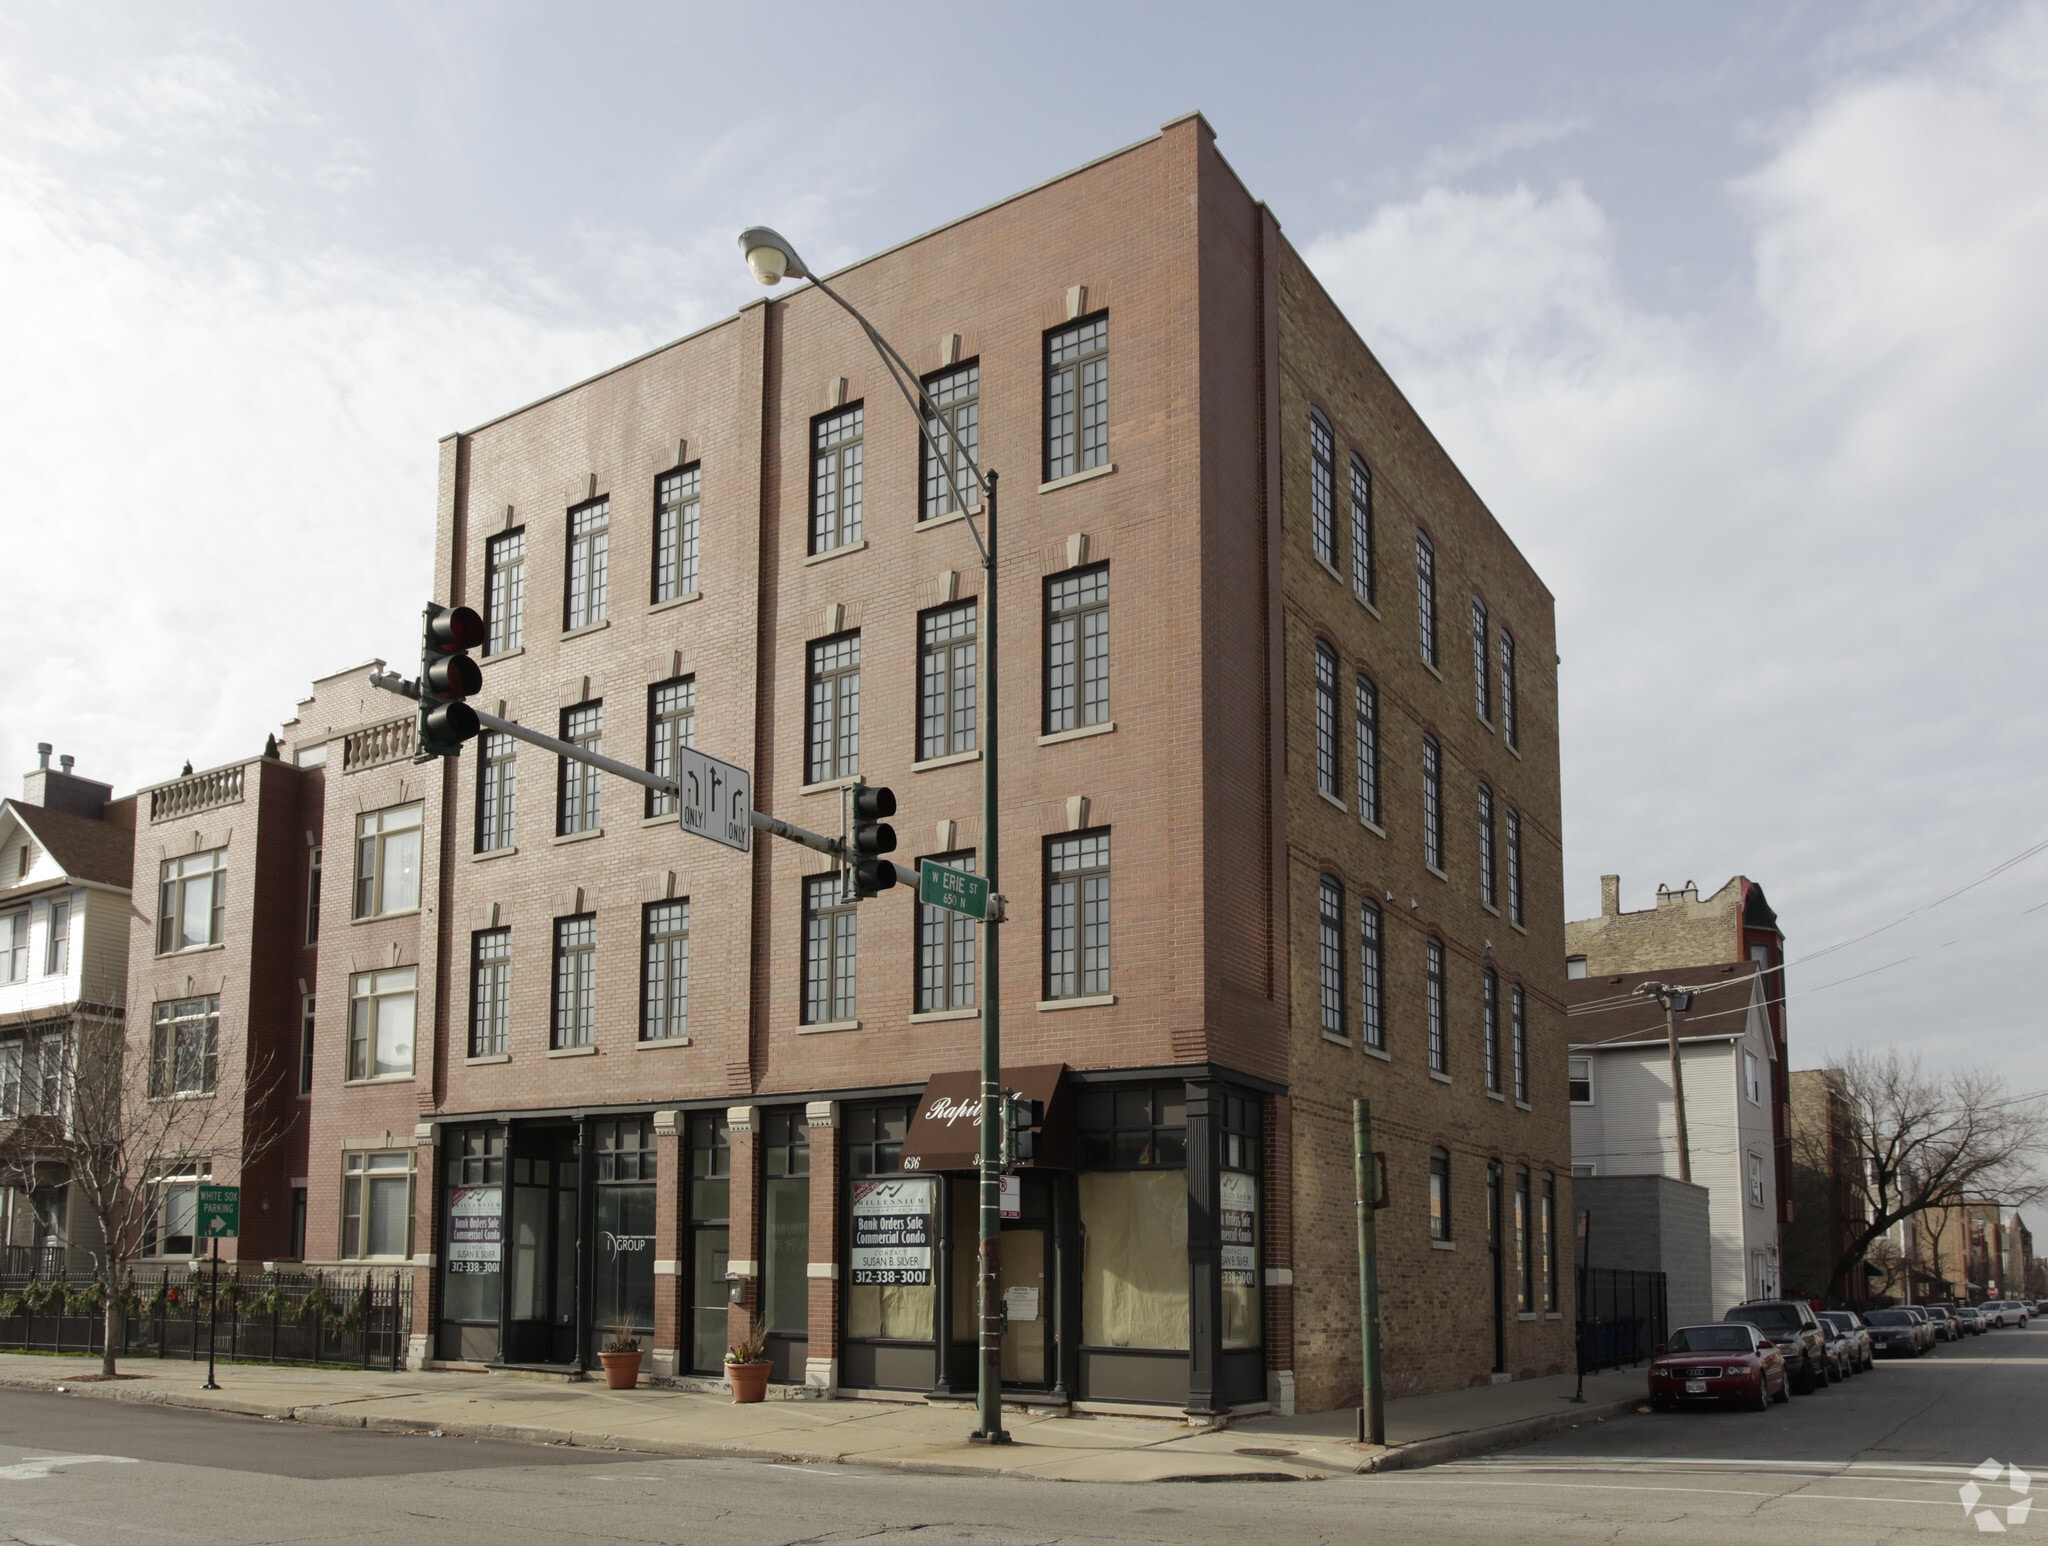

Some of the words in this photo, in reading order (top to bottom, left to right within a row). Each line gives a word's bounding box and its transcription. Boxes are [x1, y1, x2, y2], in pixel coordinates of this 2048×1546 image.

[685, 806, 703, 829] ONLY
[729, 822, 746, 844] ONLY
[932, 871, 939, 883] W
[942, 872, 965, 894] ERIE
[969, 882, 978, 894] ST
[943, 893, 957, 905] 650
[960, 897, 966, 908] N
[904, 1156, 921, 1170] 636
[200, 1191, 222, 1202] WHITE
[224, 1191, 238, 1202] SOX
[858, 1198, 923, 1206] MILLENNIUM
[203, 1203, 234, 1214] PARKING
[454, 1217, 469, 1229] Bank
[470, 1217, 487, 1229] Orders
[858, 1217, 878, 1231] Bank
[880, 1217, 905, 1230] Orders
[906, 1216, 924, 1230] Sale
[856, 1231, 899, 1245] Commercial
[901, 1230, 926, 1244] Condo
[616, 1239, 646, 1251] GROUP
[451, 1261, 500, 1273] 312-338-3001
[862, 1256, 887, 1267] SUSAN
[888, 1256, 896, 1267] B.
[897, 1256, 920, 1267] SILVER
[855, 1271, 926, 1284] 312-338-3001
